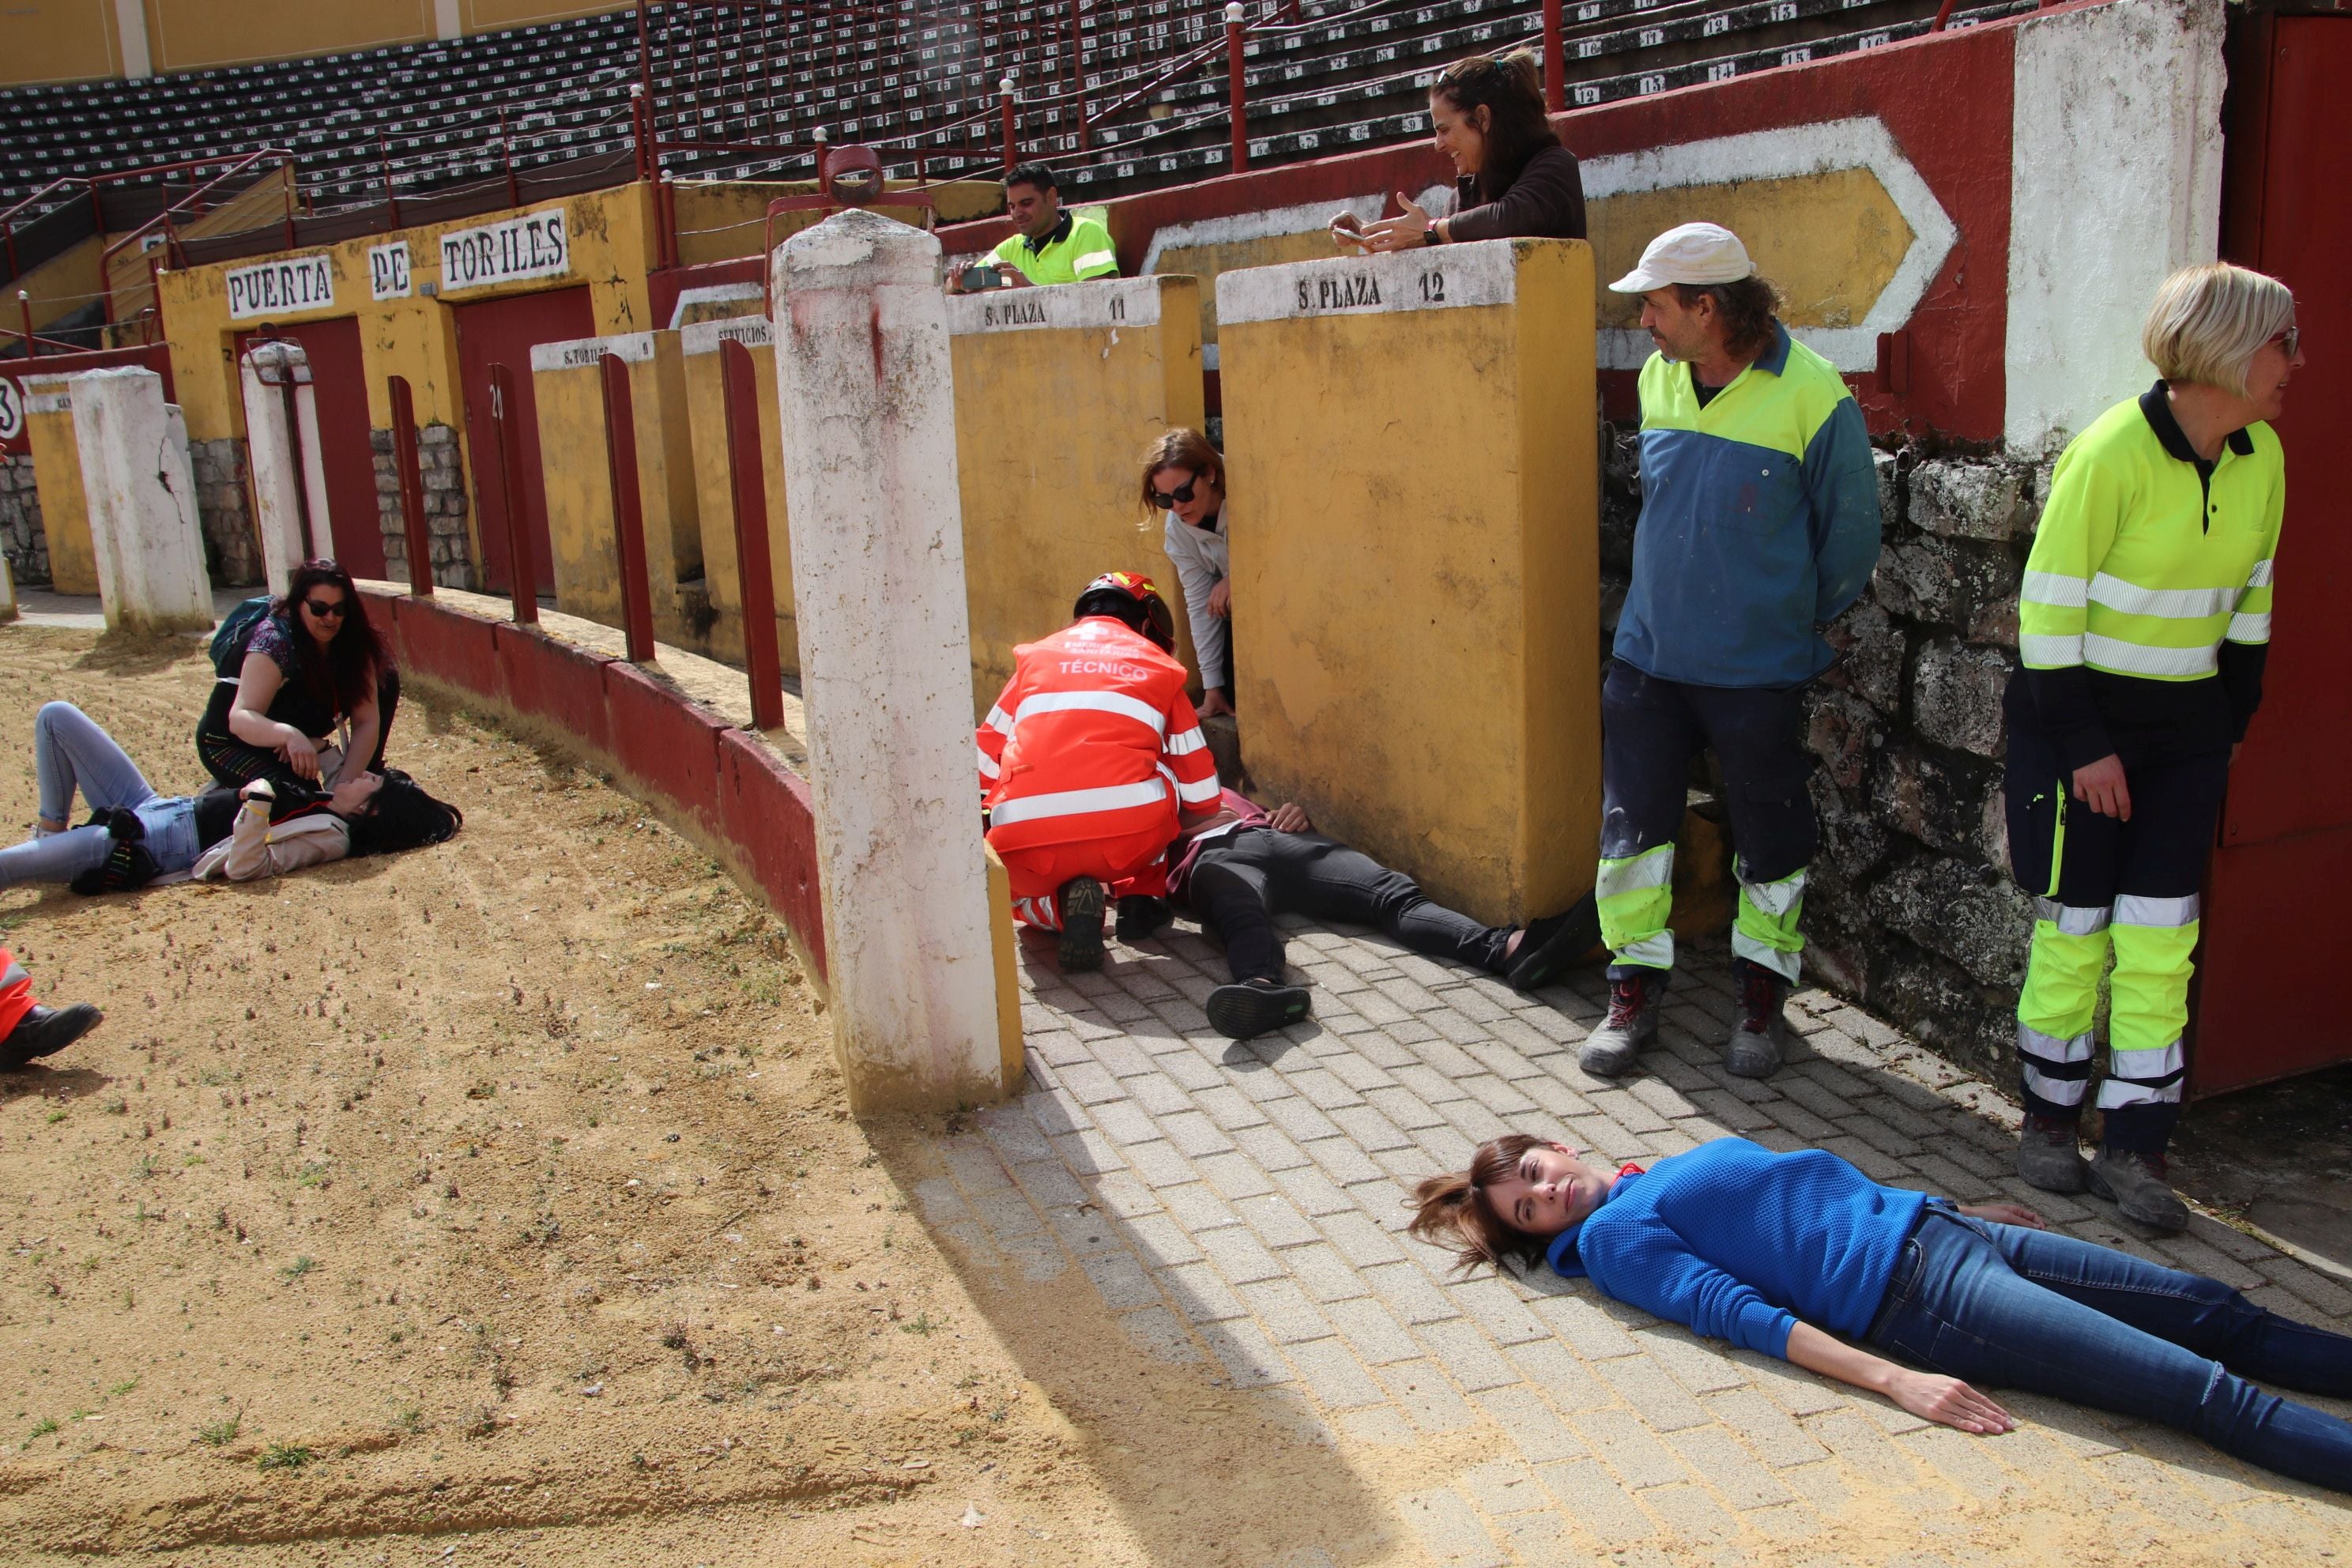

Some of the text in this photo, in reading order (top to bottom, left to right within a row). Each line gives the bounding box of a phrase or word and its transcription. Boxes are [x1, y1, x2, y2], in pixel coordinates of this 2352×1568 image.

[1709, 18, 1724, 33] 12
[1645, 76, 1661, 93] 13
[1581, 89, 1594, 104] 12
[229, 217, 564, 313] PUERTA DE TORILES
[1320, 276, 1381, 309] PLAZA
[1419, 271, 1445, 302] 12
[1004, 303, 1046, 325] PLAZA
[1109, 298, 1125, 320] 11
[489, 384, 503, 420] 20
[1059, 658, 1148, 680] TÉCNICO
